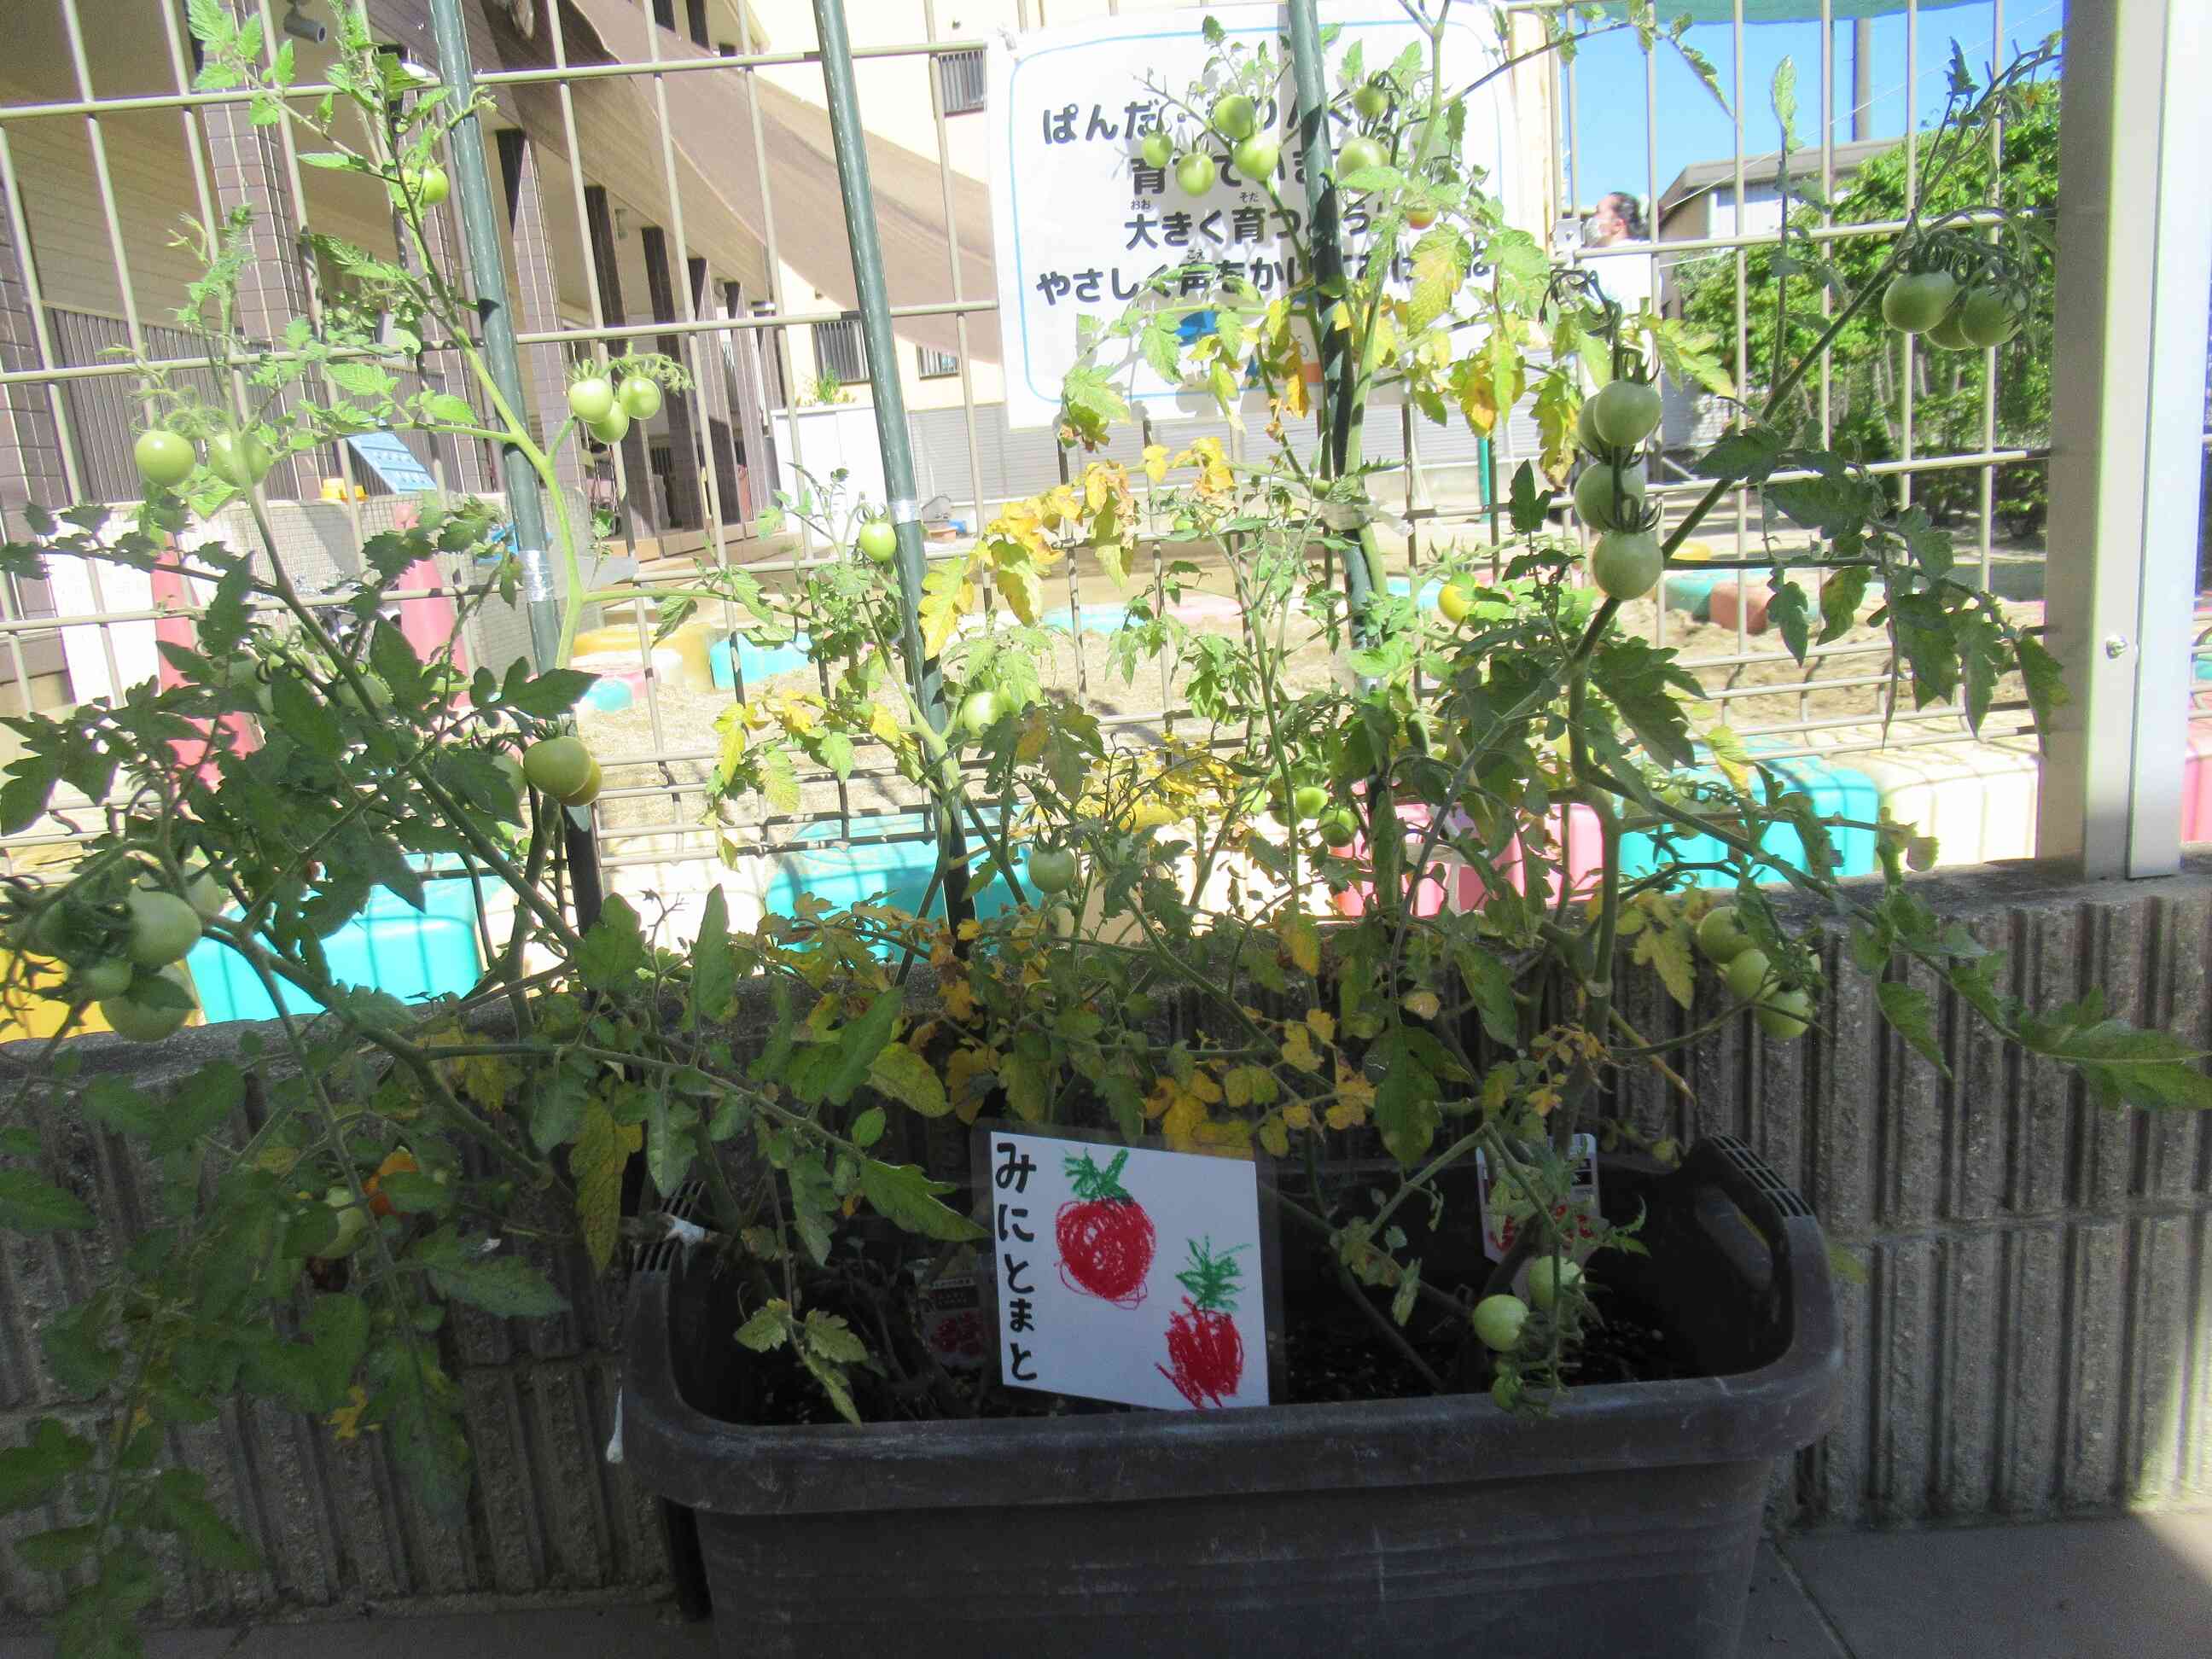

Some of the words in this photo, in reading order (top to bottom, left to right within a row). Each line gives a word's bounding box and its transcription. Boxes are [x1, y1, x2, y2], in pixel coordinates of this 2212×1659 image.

[1124, 203, 1398, 250] 大きく育つう
[995, 1141, 1038, 1382] みにとまと
